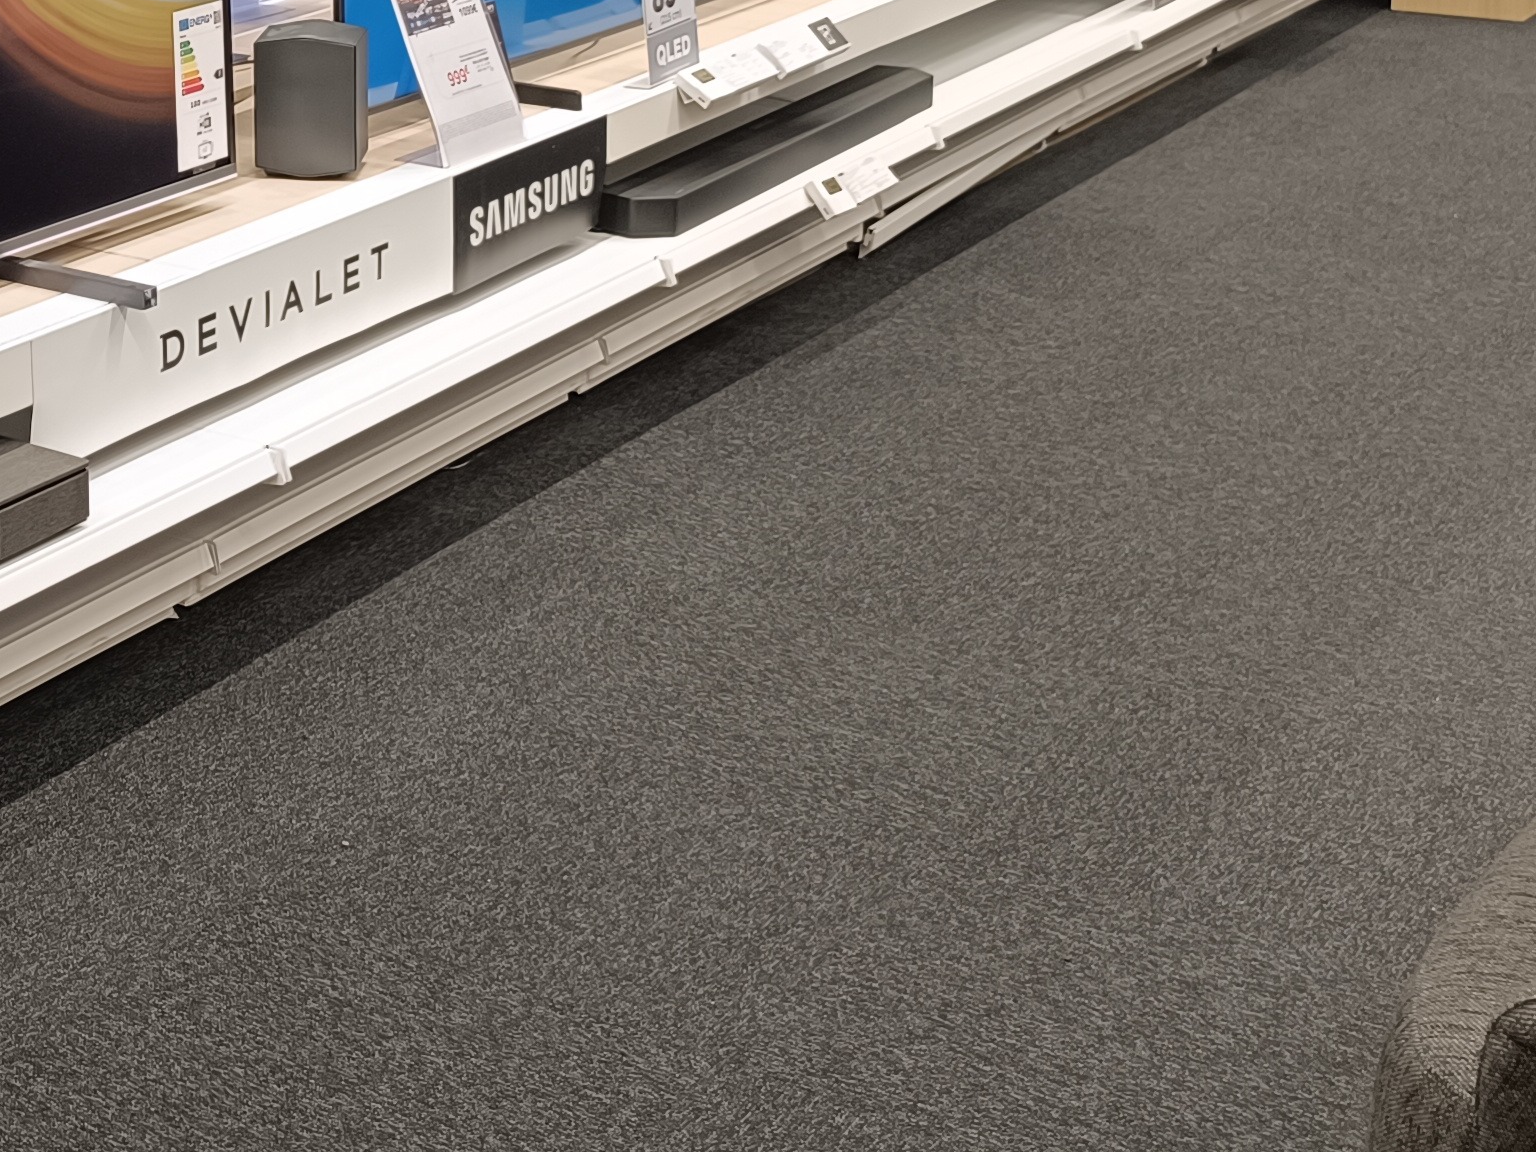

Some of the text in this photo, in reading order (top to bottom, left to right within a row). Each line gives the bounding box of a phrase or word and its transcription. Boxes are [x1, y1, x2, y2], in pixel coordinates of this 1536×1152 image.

[656, 34, 691, 66] QLED
[469, 158, 595, 247] SAMSUNG
[159, 241, 390, 374] DEVIALET
